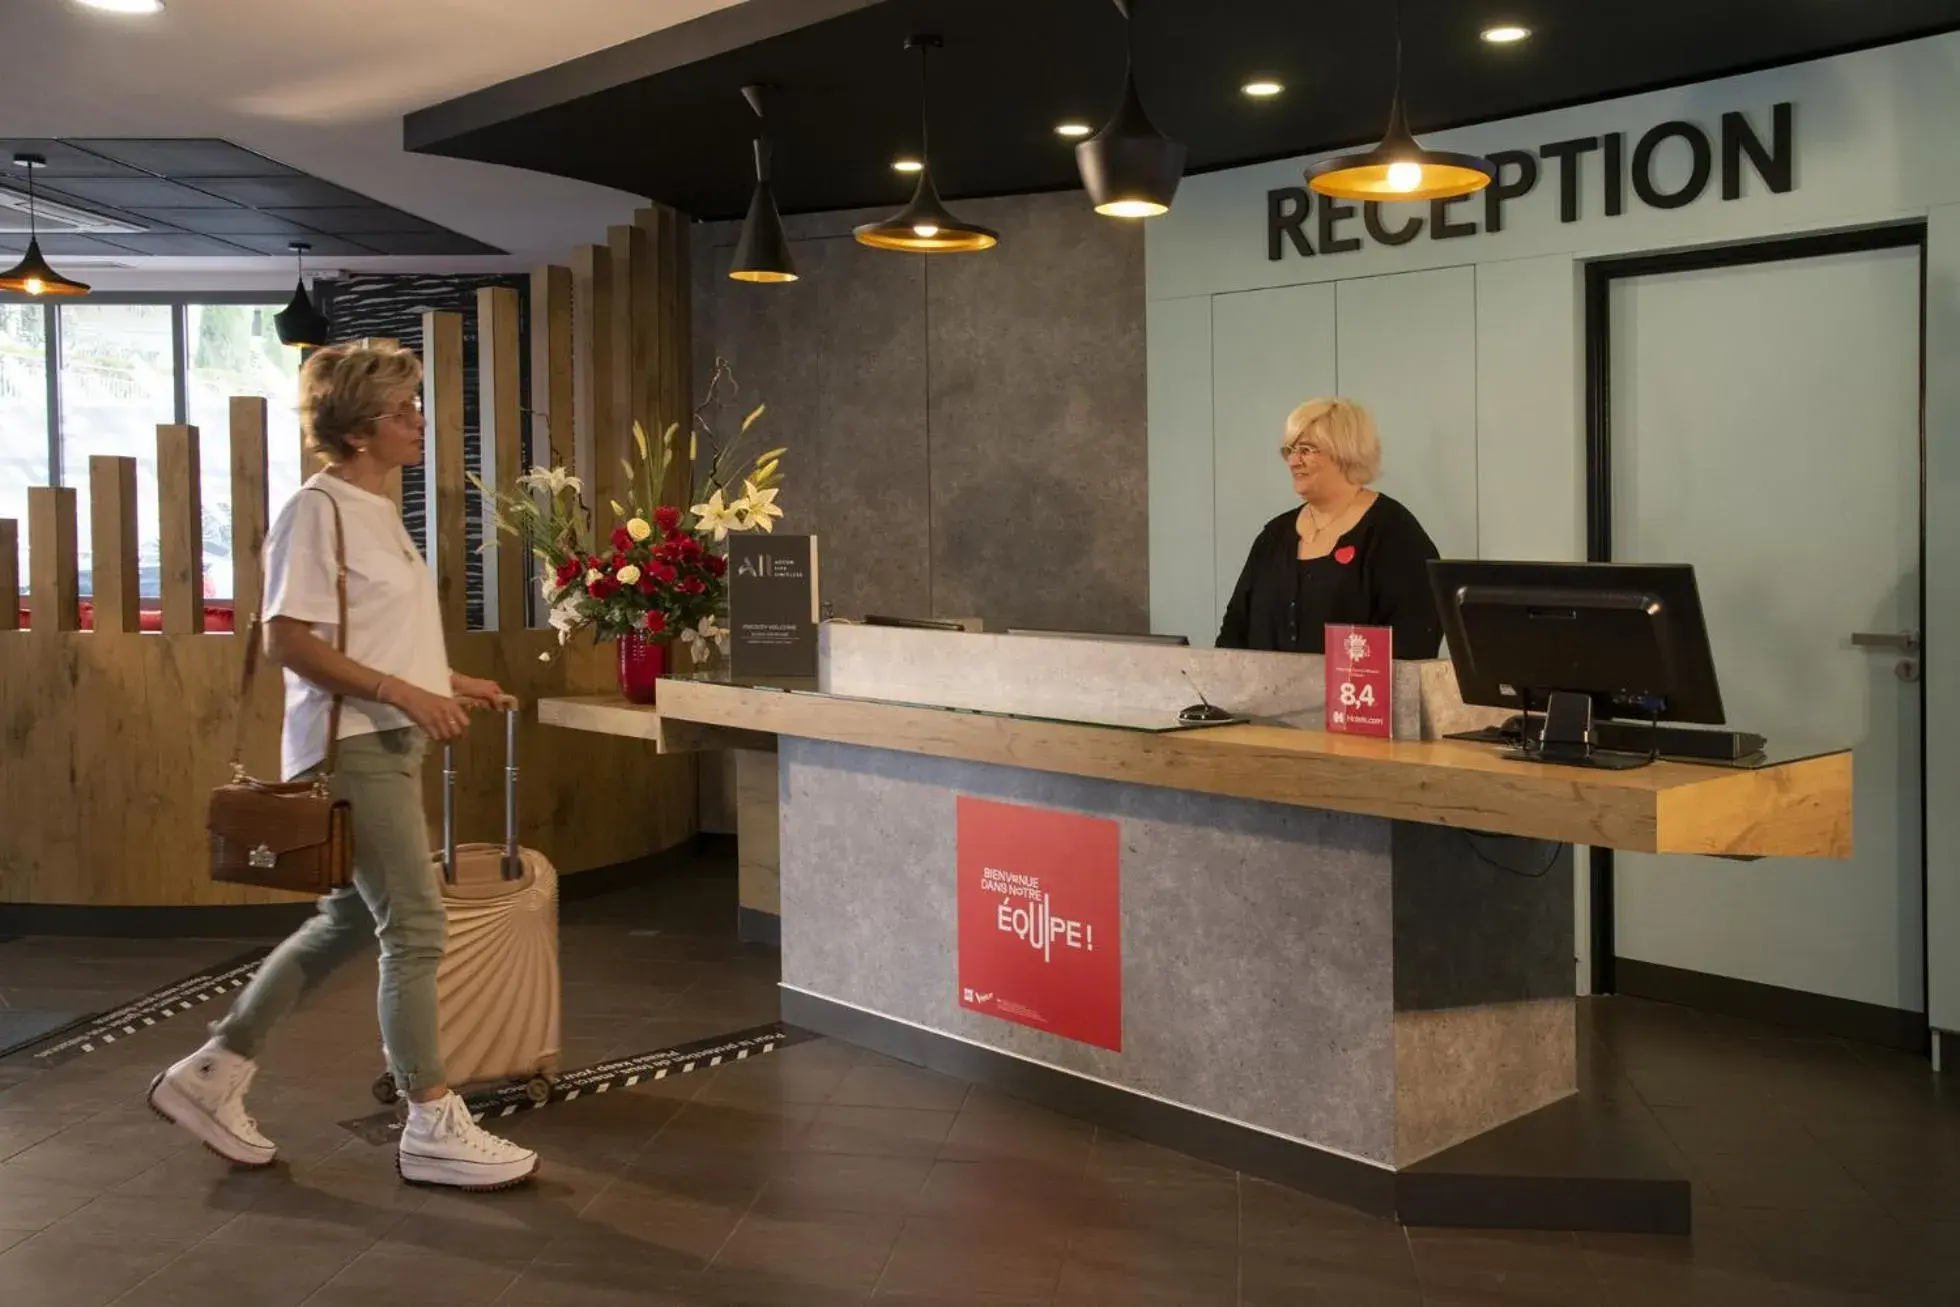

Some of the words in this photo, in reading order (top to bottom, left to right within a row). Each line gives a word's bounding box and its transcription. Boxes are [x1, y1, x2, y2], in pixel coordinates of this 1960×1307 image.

[1267, 101, 1795, 262] RECEPTION
[1340, 682, 1376, 710] 8,4
[981, 878, 1008, 894] DANS
[1008, 884, 1042, 902] NOTRE
[983, 867, 1039, 889] BIENVENUE
